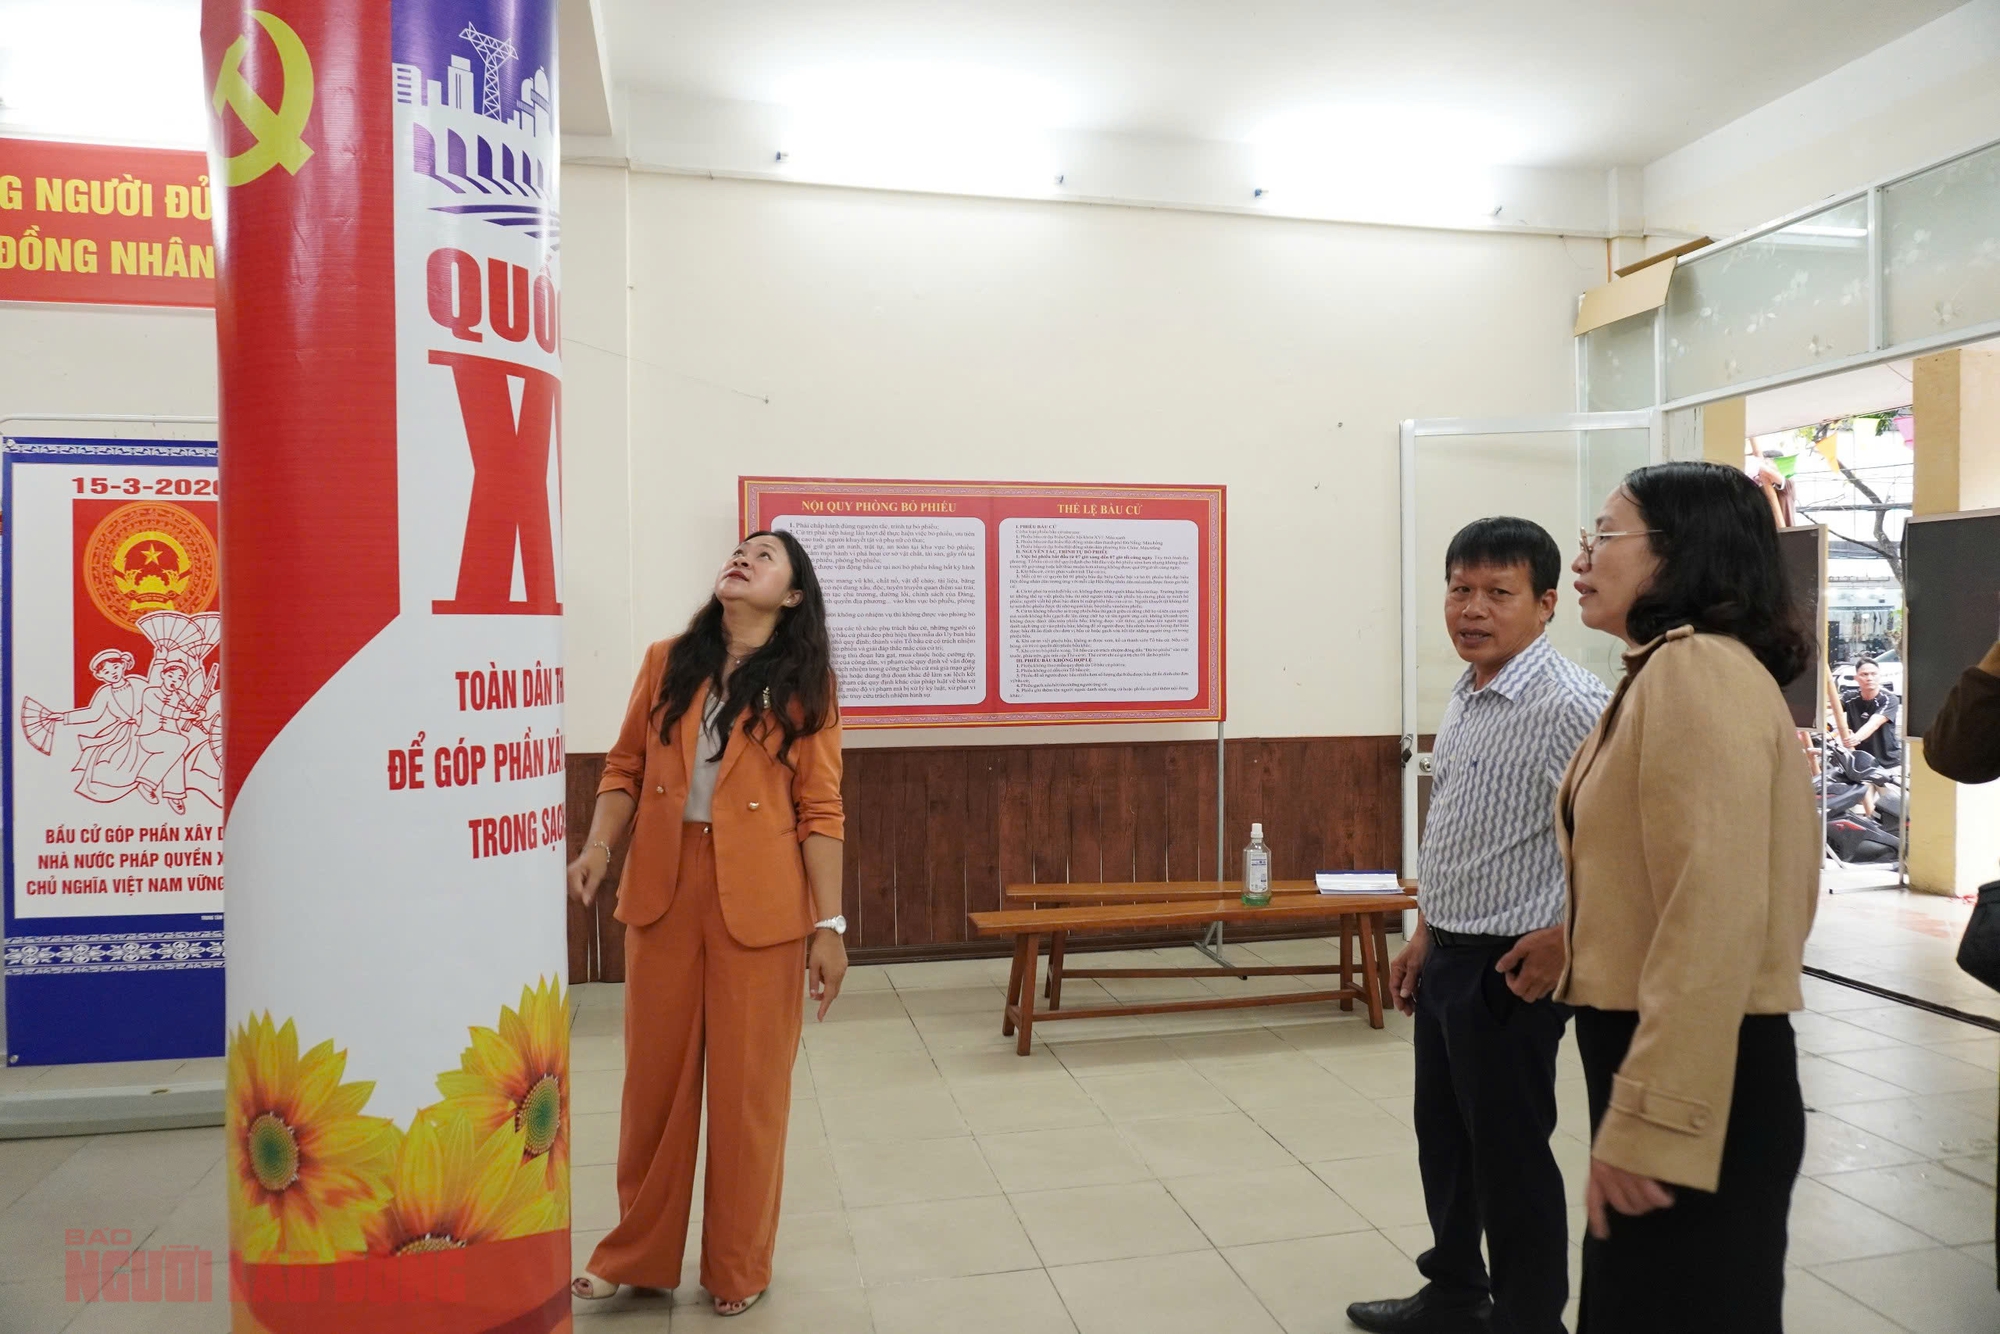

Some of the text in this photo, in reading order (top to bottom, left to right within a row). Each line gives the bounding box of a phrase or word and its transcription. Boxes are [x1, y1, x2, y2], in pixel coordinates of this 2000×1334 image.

[35, 174, 152, 217] NGƯỜI
[165, 175, 212, 220] ĐỦ
[0, 225, 215, 279] ĐỒNG NHÂN
[426, 247, 562, 362] QUỐ
[802, 500, 956, 513] NỘI QUY PHÒNG BỎ PHIẾU
[1057, 502, 1142, 516] THỂ LỆ BẦU CỬ
[455, 662, 517, 711] TOÀN
[523, 660, 552, 707] DÂN
[388, 727, 565, 790] ĐỂ GÓP PHẦN XÂ
[81, 824, 101, 843] CỬ
[105, 825, 134, 842] GÓP
[184, 824, 212, 841] XÂY
[469, 802, 566, 859] TRONG SẠC
[38, 851, 69, 870] NHÀ
[74, 851, 114, 869] NƯỚC
[120, 850, 159, 868] PHÁP
[26, 874, 224, 896] CHỦ NGHĨA VIỆT NAM VỮNG
